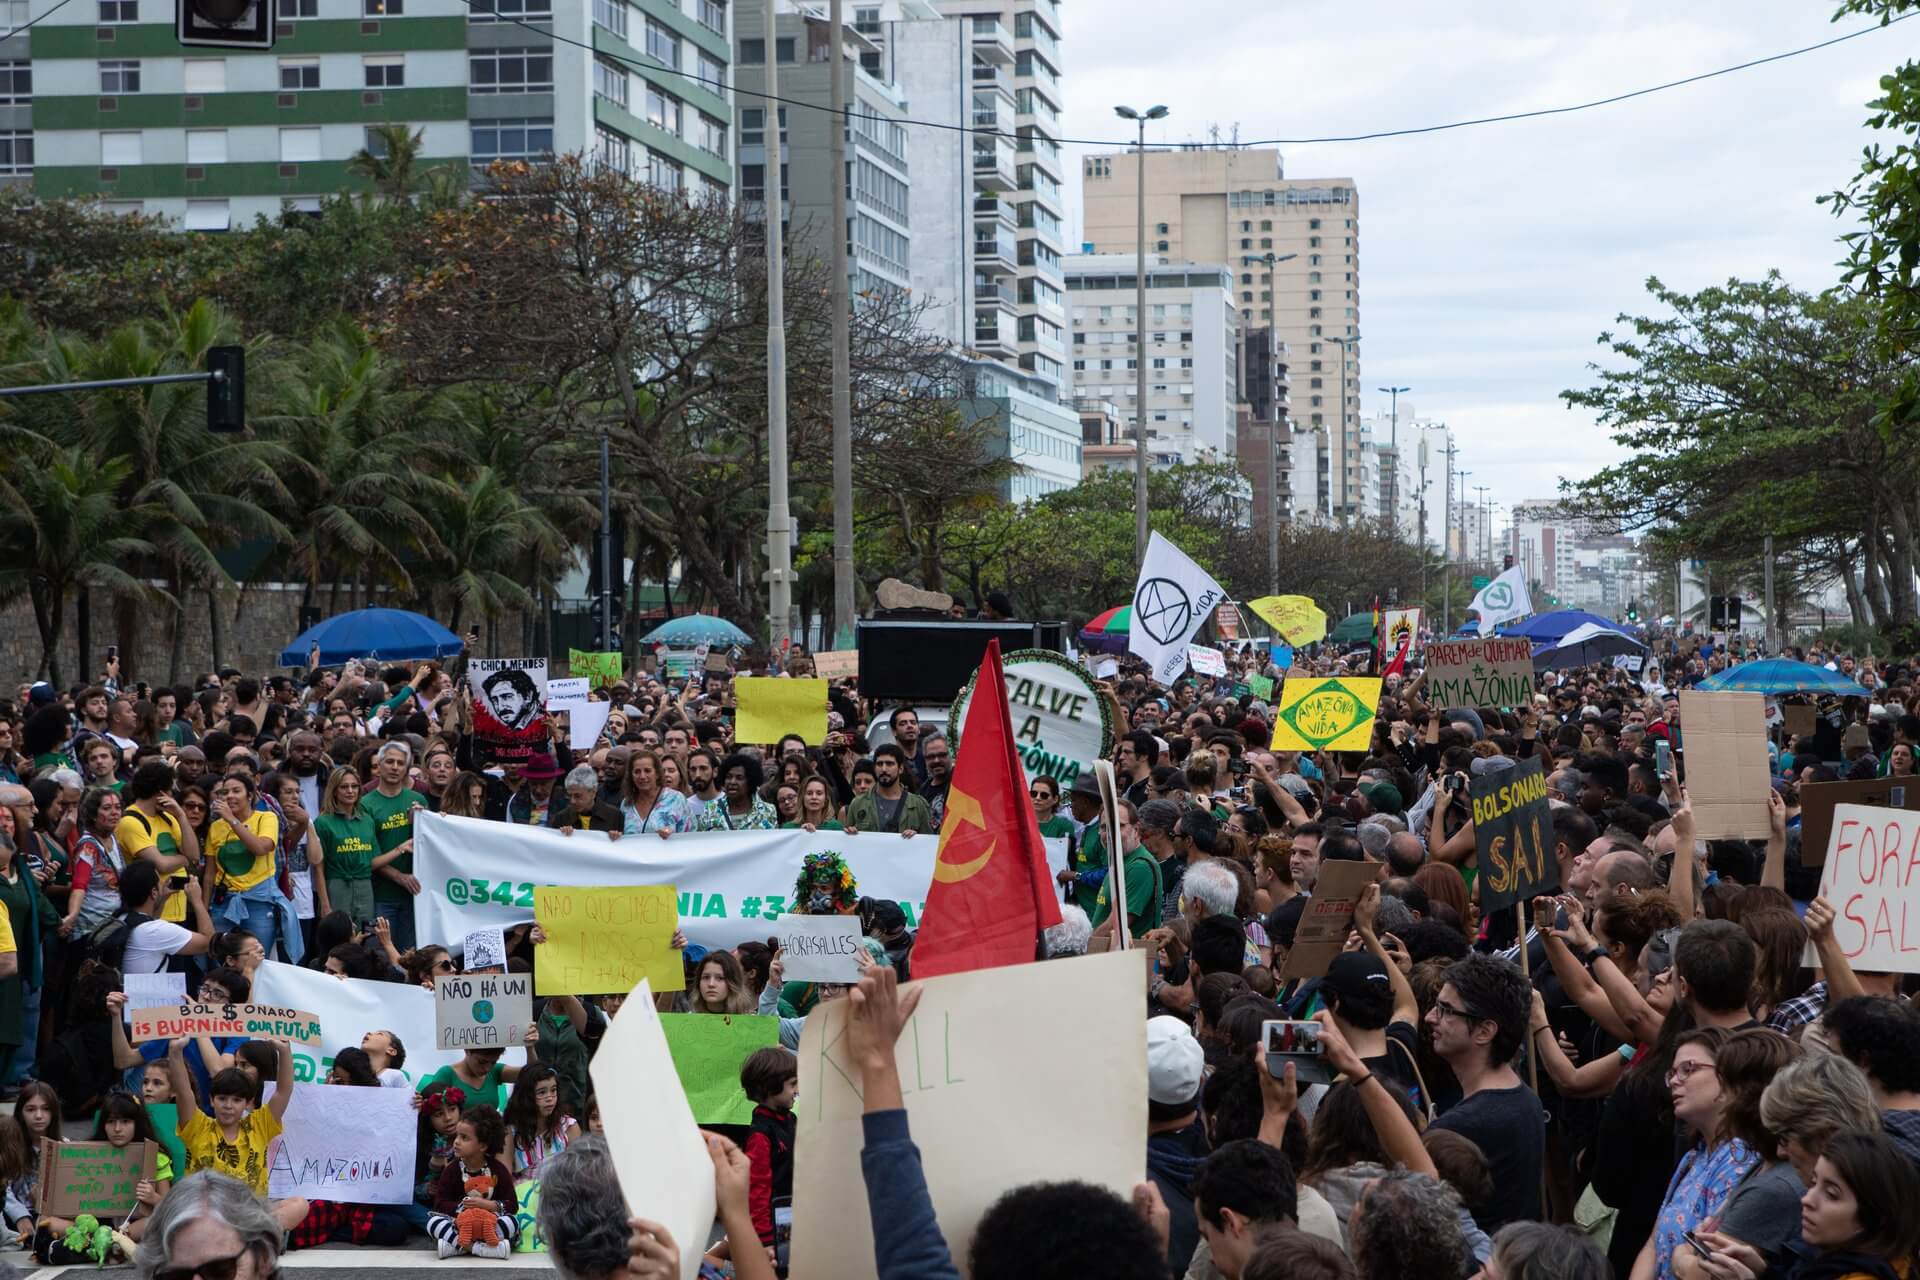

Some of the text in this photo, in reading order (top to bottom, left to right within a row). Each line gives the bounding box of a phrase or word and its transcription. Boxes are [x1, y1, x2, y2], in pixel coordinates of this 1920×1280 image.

[1192, 589, 1218, 617] VIDA
[480, 659, 508, 671] CHICO
[509, 658, 545, 670] MENDES
[608, 655, 619, 671] A
[1427, 640, 1532, 667] PAREM de QUEIMAR
[1018, 714, 1041, 743] A
[1306, 721, 1339, 735] VIDA
[1473, 771, 1547, 826] BOLSONARO
[1488, 815, 1545, 893] SAI
[442, 975, 526, 1000] NÃO HÁ UM
[246, 1019, 274, 1036] OUR
[275, 1020, 321, 1041] FUTURE
[444, 1024, 518, 1048] PLANETA B
